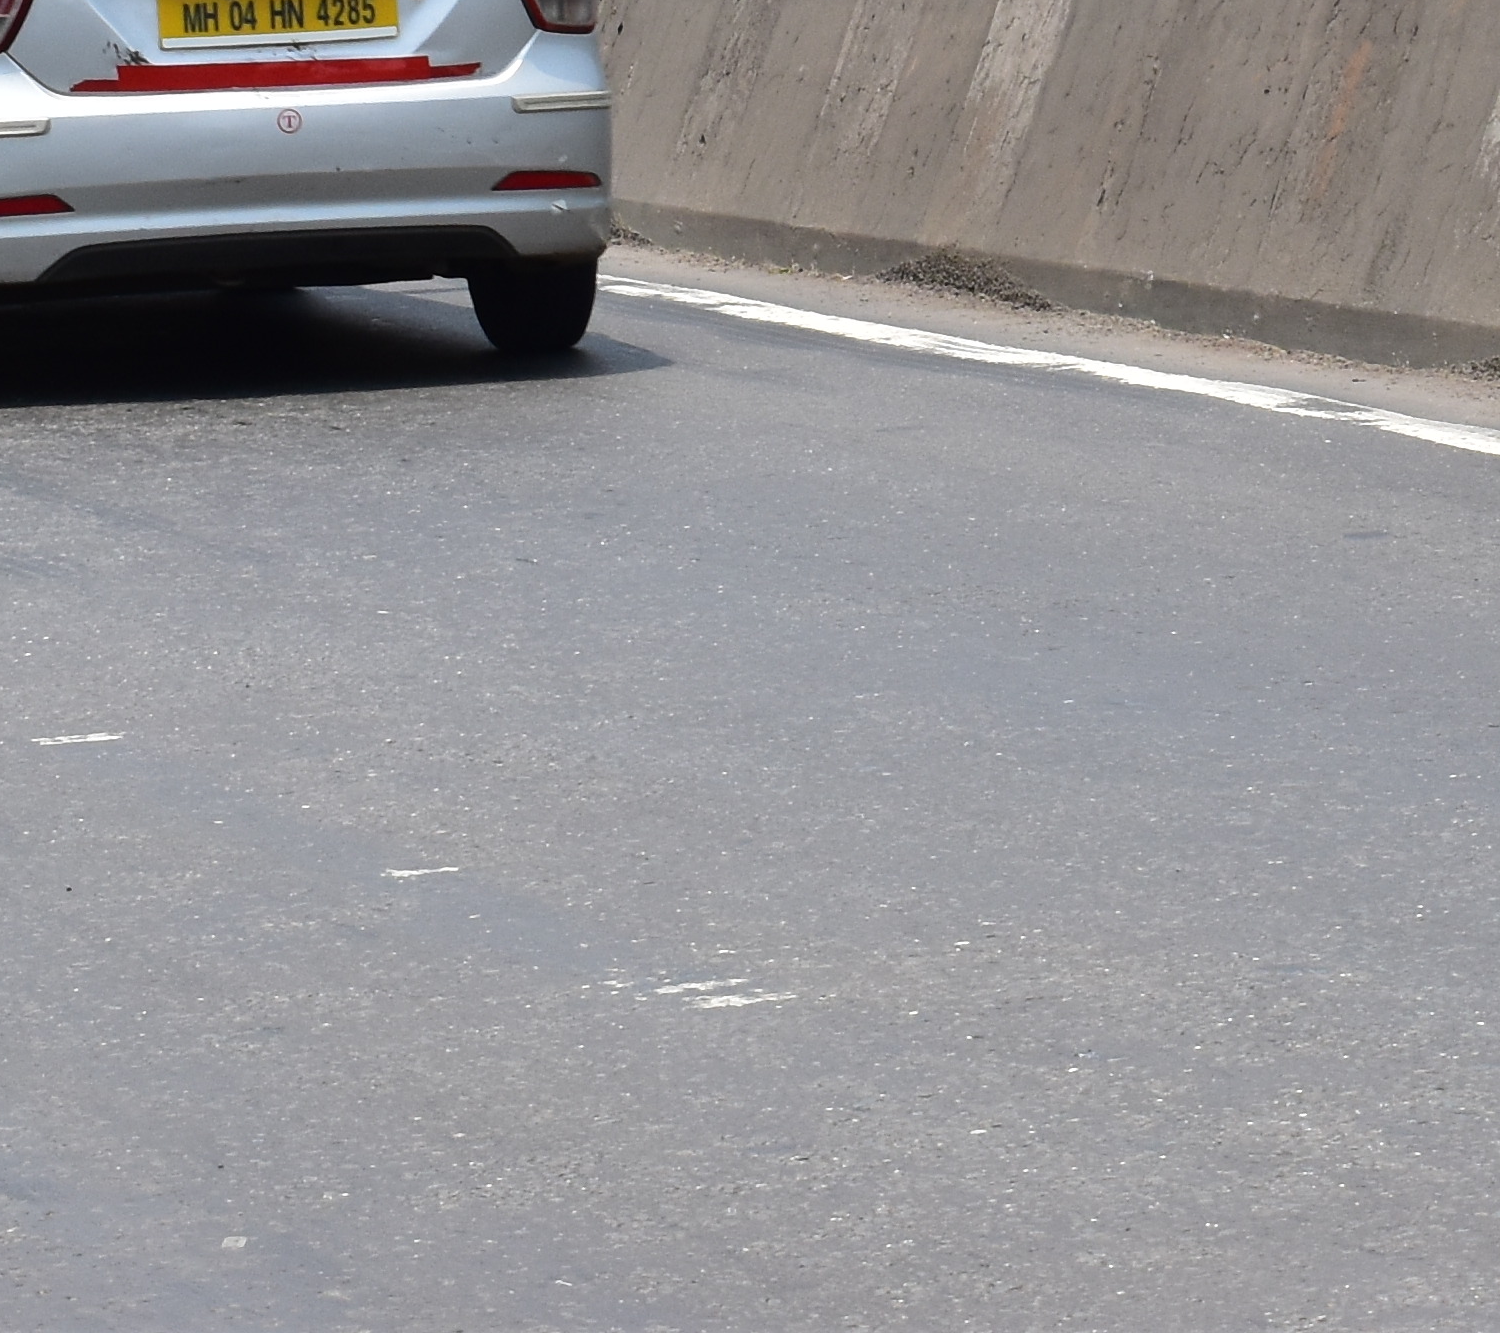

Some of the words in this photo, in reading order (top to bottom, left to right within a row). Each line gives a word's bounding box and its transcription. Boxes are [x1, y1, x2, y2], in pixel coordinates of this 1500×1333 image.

[183, 2, 219, 33] MH
[229, 0, 257, 31] 04
[270, 0, 304, 29] HN
